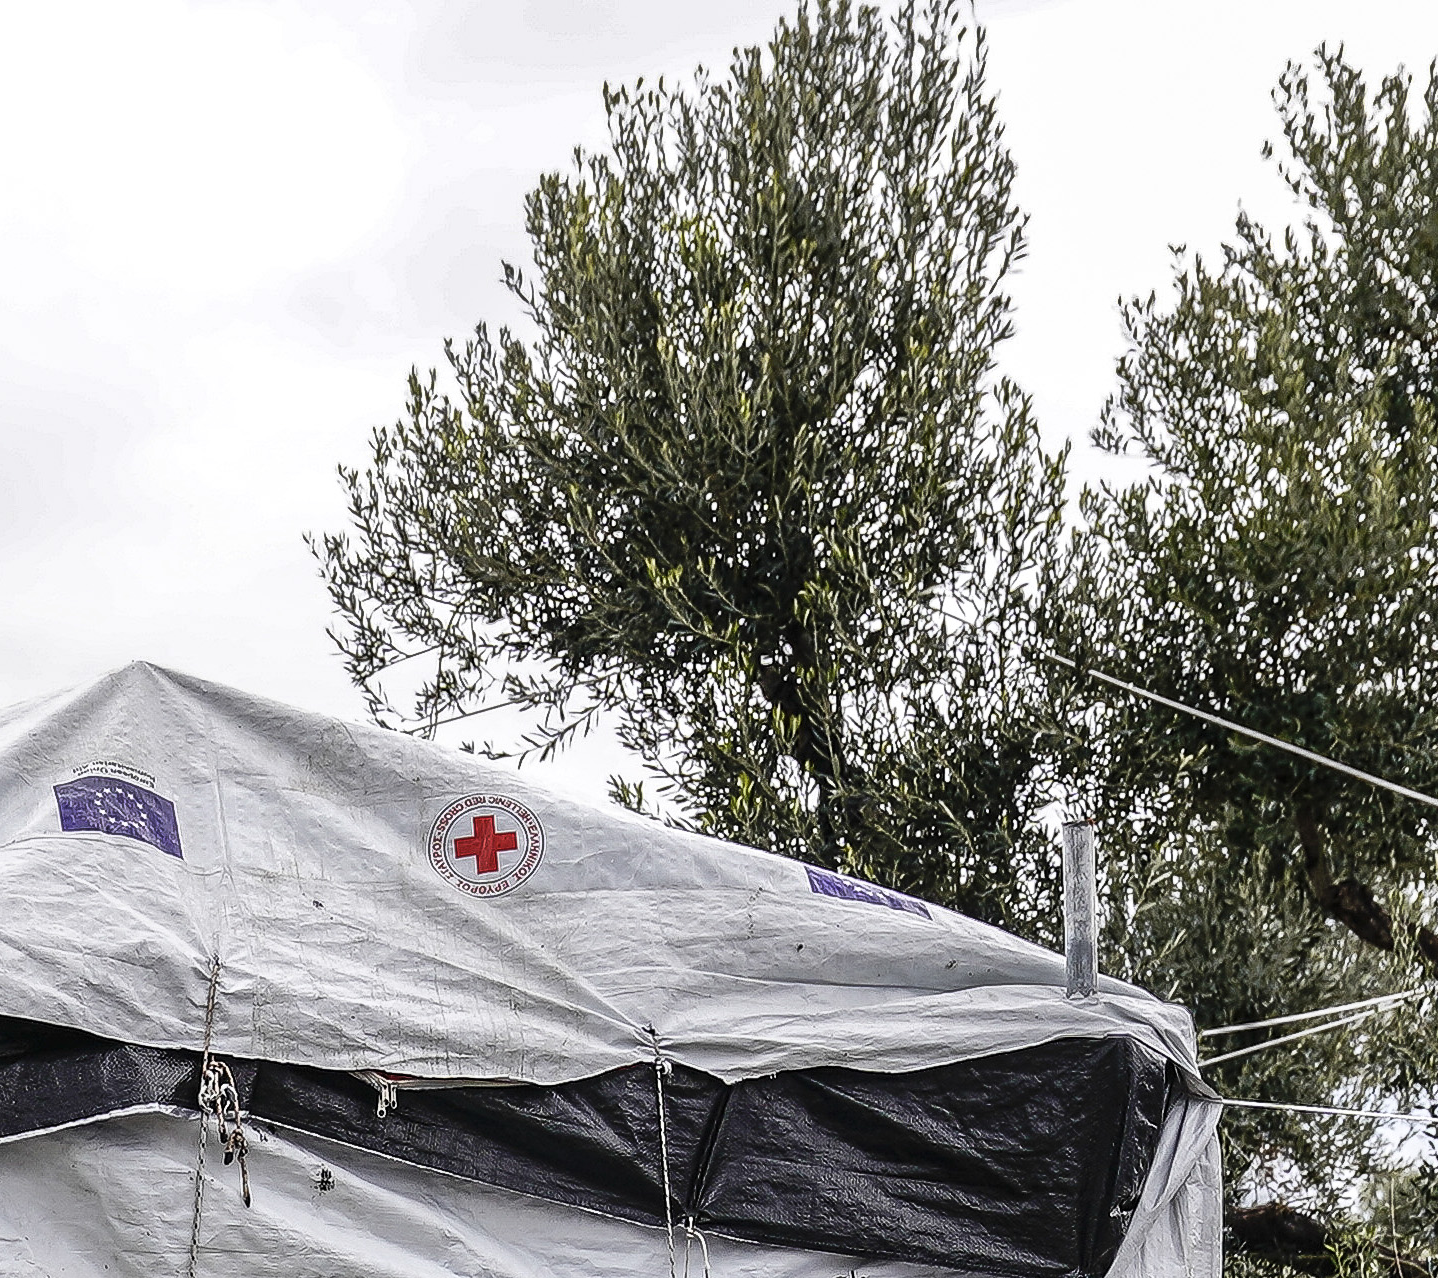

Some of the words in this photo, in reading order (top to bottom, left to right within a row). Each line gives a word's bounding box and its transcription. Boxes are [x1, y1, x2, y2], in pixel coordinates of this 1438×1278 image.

[466, 796, 486, 807] RED
[488, 796, 532, 825] HELLENIC
[436, 803, 464, 832] CROSS
